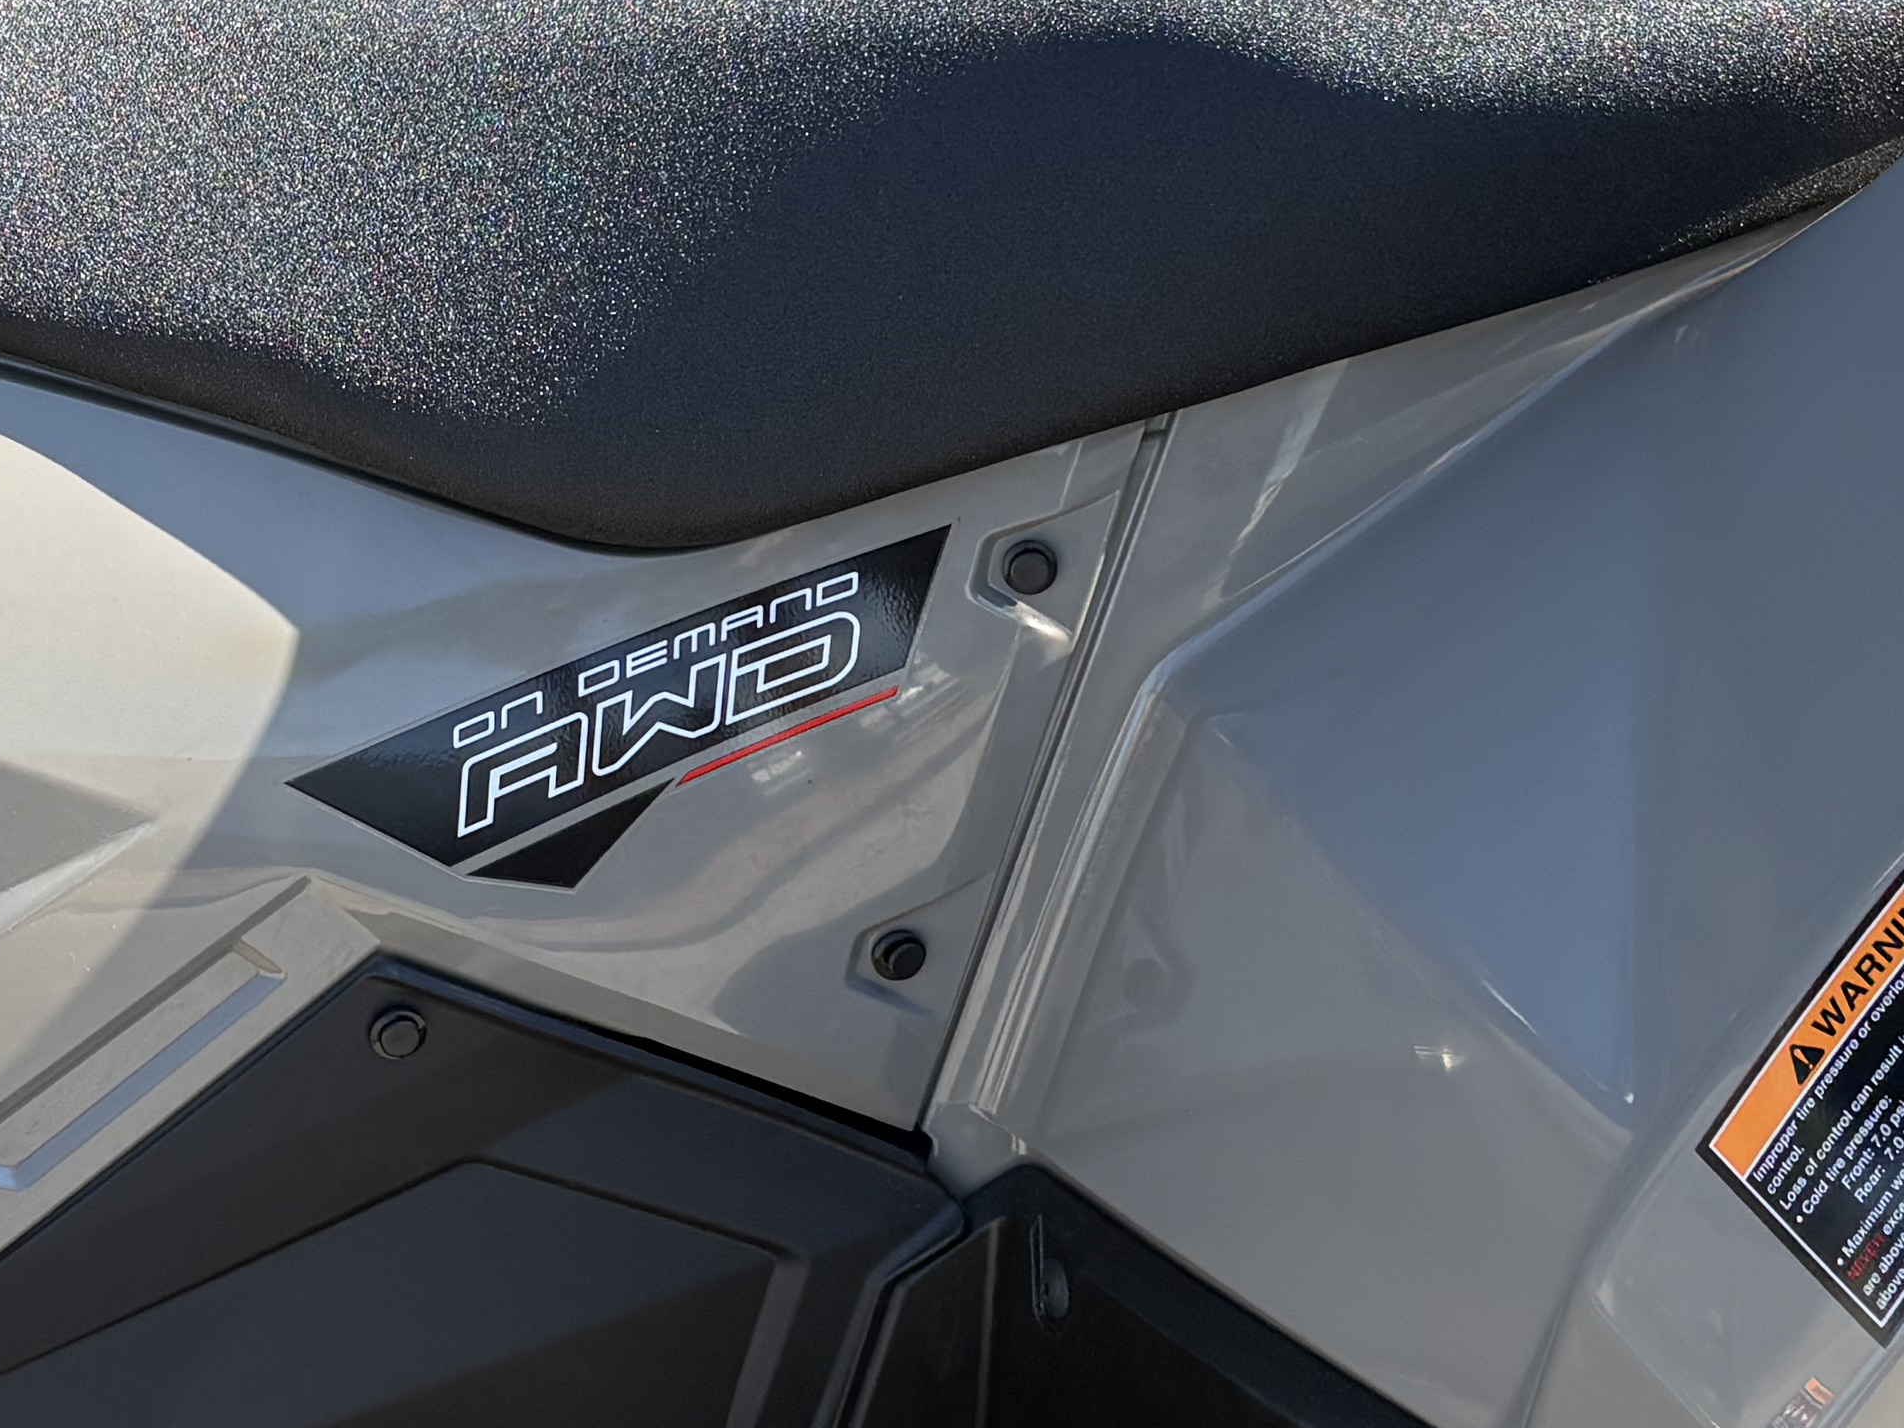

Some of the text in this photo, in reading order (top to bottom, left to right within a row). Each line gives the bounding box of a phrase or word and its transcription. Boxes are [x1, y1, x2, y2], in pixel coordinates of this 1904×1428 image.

[454, 571, 859, 749] ON DEMAND
[457, 611, 861, 838] AWD
[1752, 1120, 1798, 1182] Improper
[1795, 1097, 1816, 1121] tire
[1814, 1039, 1859, 1100] pressure
[1858, 1020, 1871, 1039] or
[1779, 1176, 1807, 1210] Loss
[1804, 1157, 1818, 1176] of
[1816, 1110, 1854, 1161] control
[1851, 1085, 1873, 1112] can
[1870, 1045, 1903, 1086] result
[1767, 1144, 1805, 1195] control.
[1802, 1095, 1892, 1214] Cold tire pressure:
[1841, 1148, 1875, 1190] Front:
[1870, 1123, 1892, 1148] 7.0
[1854, 1164, 1886, 1203] Rear:
[1883, 1136, 1904, 1161] 7.0
[1841, 1191, 1893, 1258] Maximum
[1862, 1272, 1881, 1297] are
